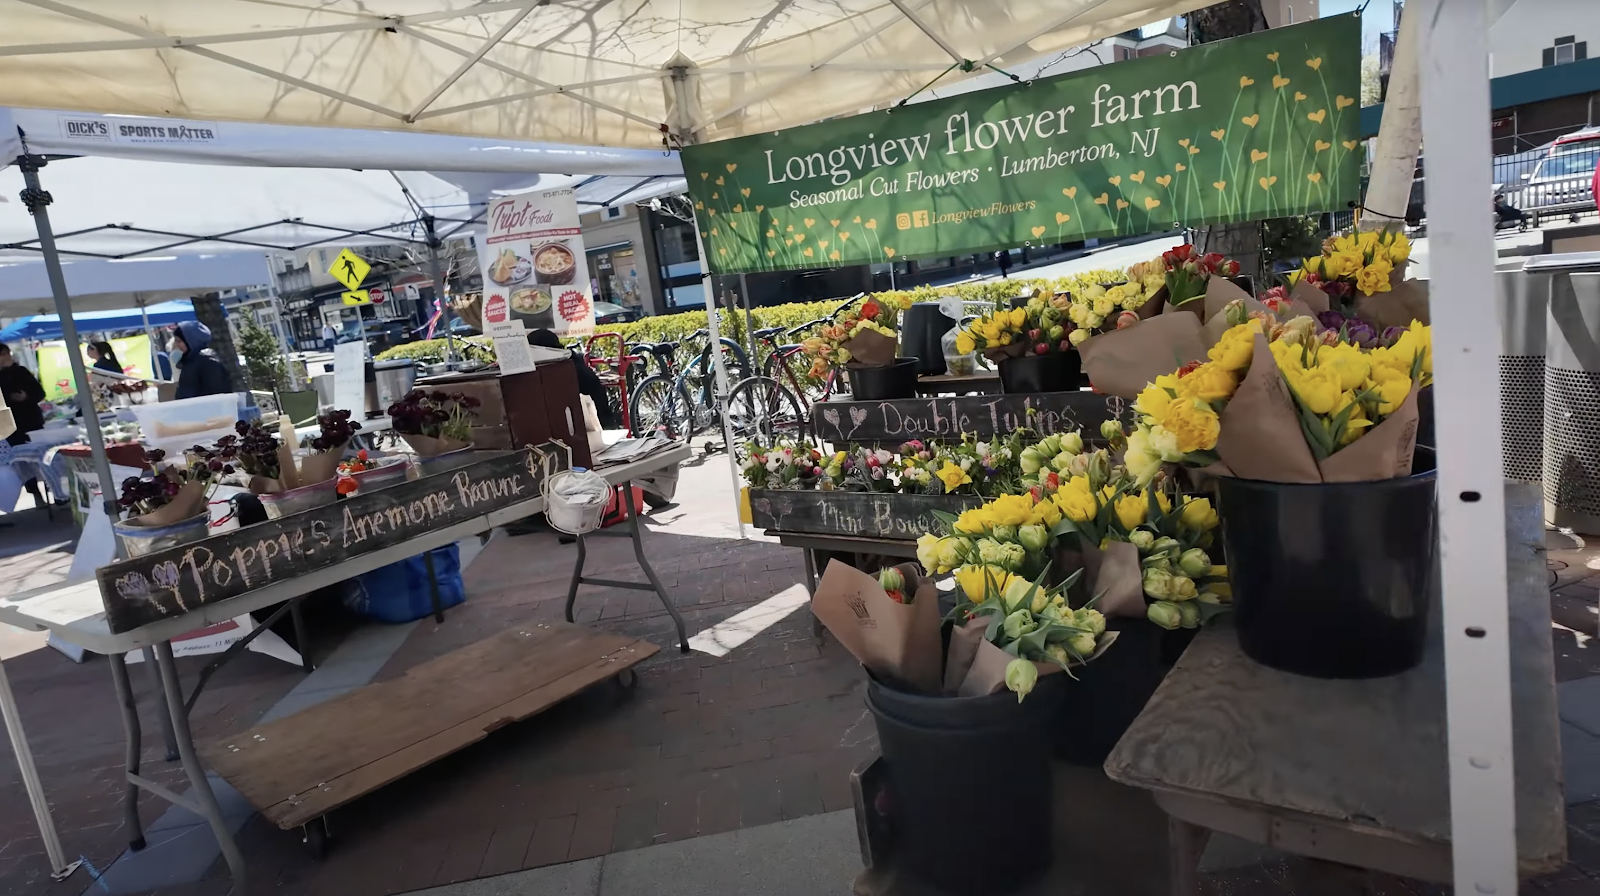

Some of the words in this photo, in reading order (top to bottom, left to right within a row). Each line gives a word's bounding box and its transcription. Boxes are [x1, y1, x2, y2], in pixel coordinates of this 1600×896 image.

[67, 121, 108, 135] DICK'S
[119, 125, 166, 138] SPORTS
[764, 131, 932, 187] Longview
[944, 103, 1076, 155] flower
[1091, 79, 1202, 130] farm
[789, 180, 865, 210] Seasonal
[870, 175, 900, 197] Cut
[905, 165, 980, 194] Flowers
[1000, 141, 1121, 178] Lumberton,
[1129, 127, 1161, 157] NJ
[491, 199, 533, 234] Tript
[529, 209, 554, 227] Foods
[931, 200, 1037, 225] LongviewFlowers
[563, 293, 577, 301] HOT
[563, 300, 581, 308] MEAL
[563, 305, 586, 315] PACKS
[878, 399, 971, 436] Double
[980, 396, 1077, 435] Tulips
[816, 499, 865, 535] Mini
[179, 520, 331, 602] Poppies
[342, 489, 455, 548] Anemone
